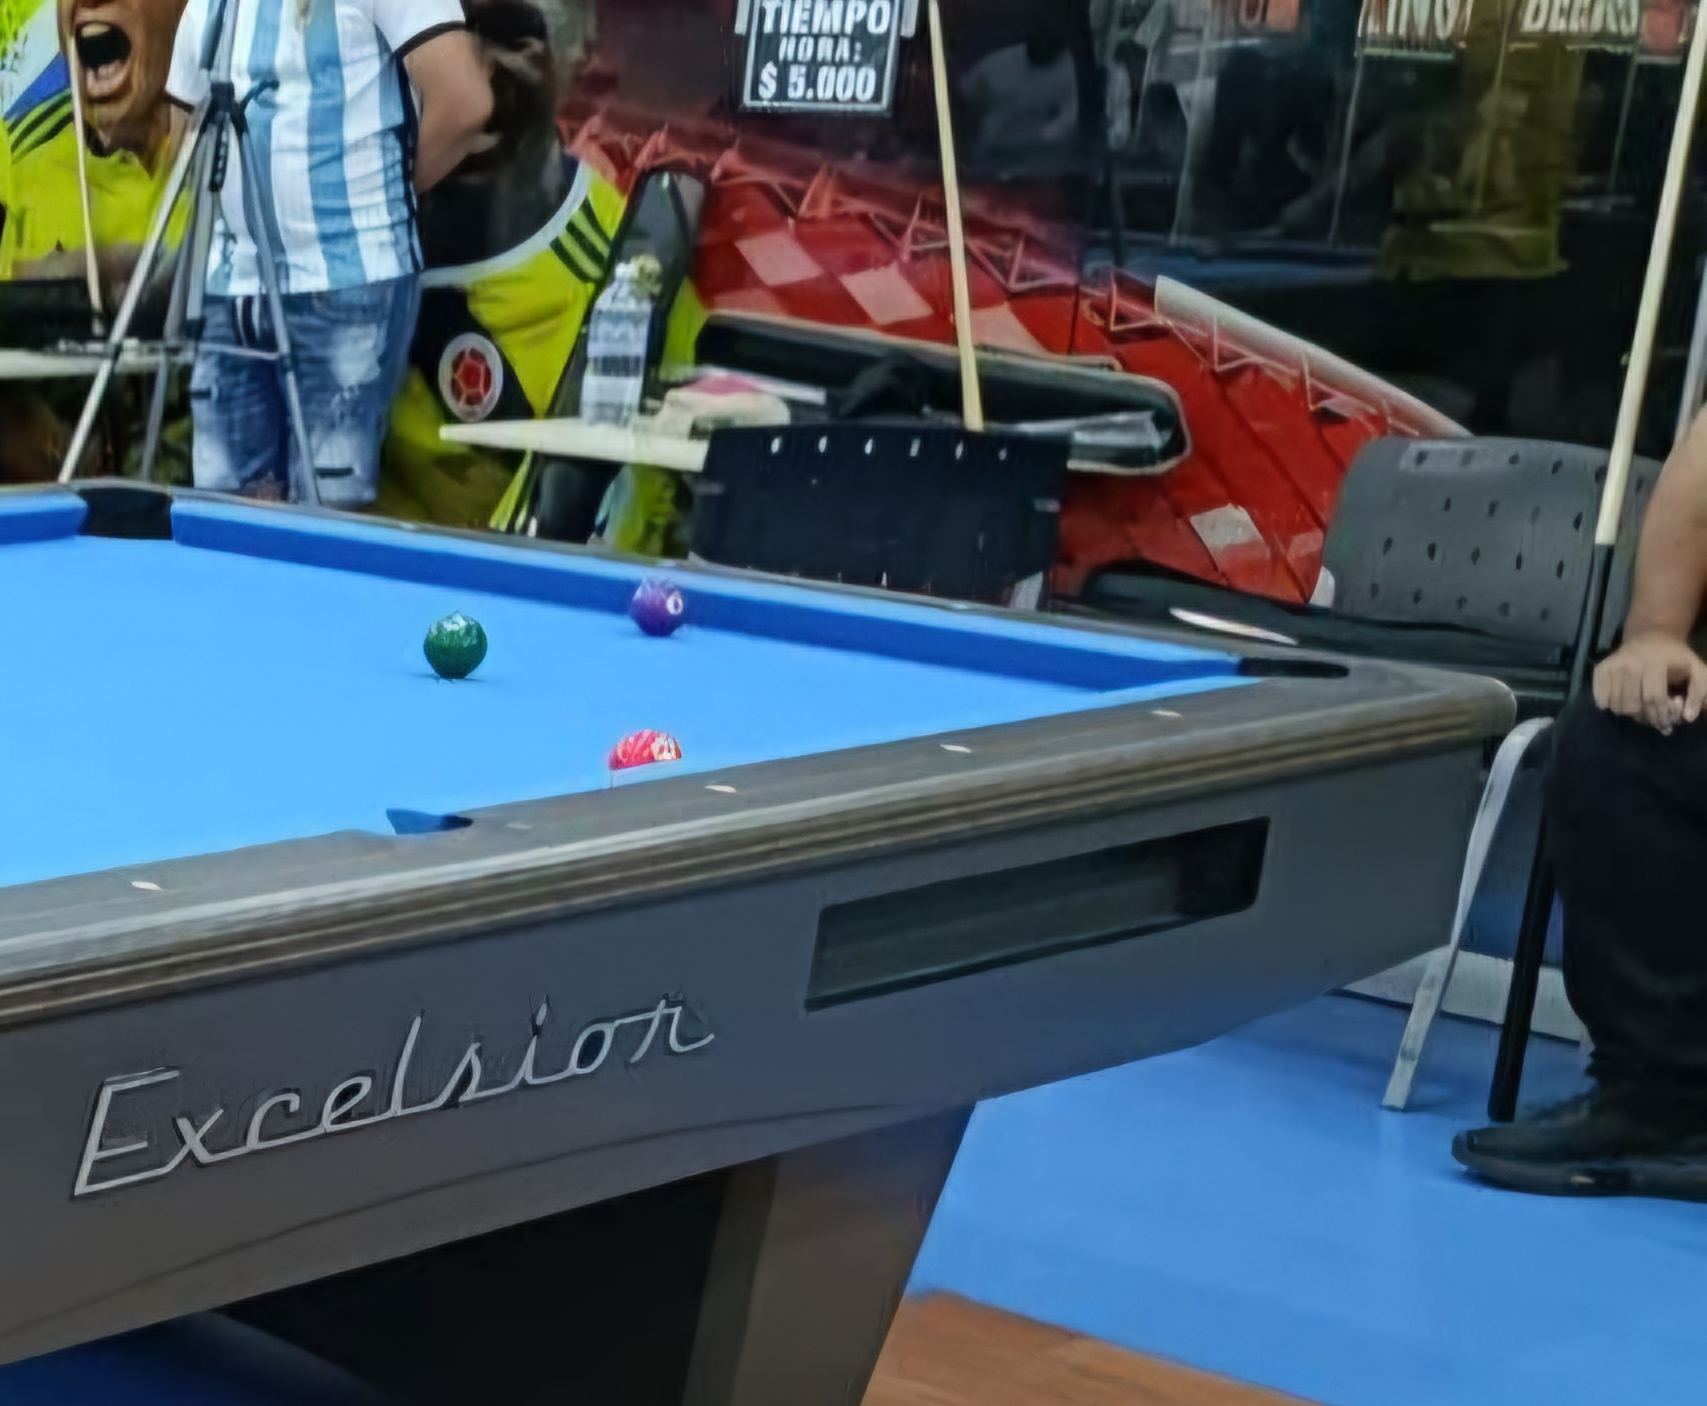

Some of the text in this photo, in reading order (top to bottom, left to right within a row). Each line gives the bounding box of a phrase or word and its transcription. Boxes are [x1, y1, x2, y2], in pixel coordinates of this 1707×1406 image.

[762, 0, 891, 35] TIEMPO
[758, 61, 876, 101] $ 5.000
[73, 995, 715, 1197] Excelsior
